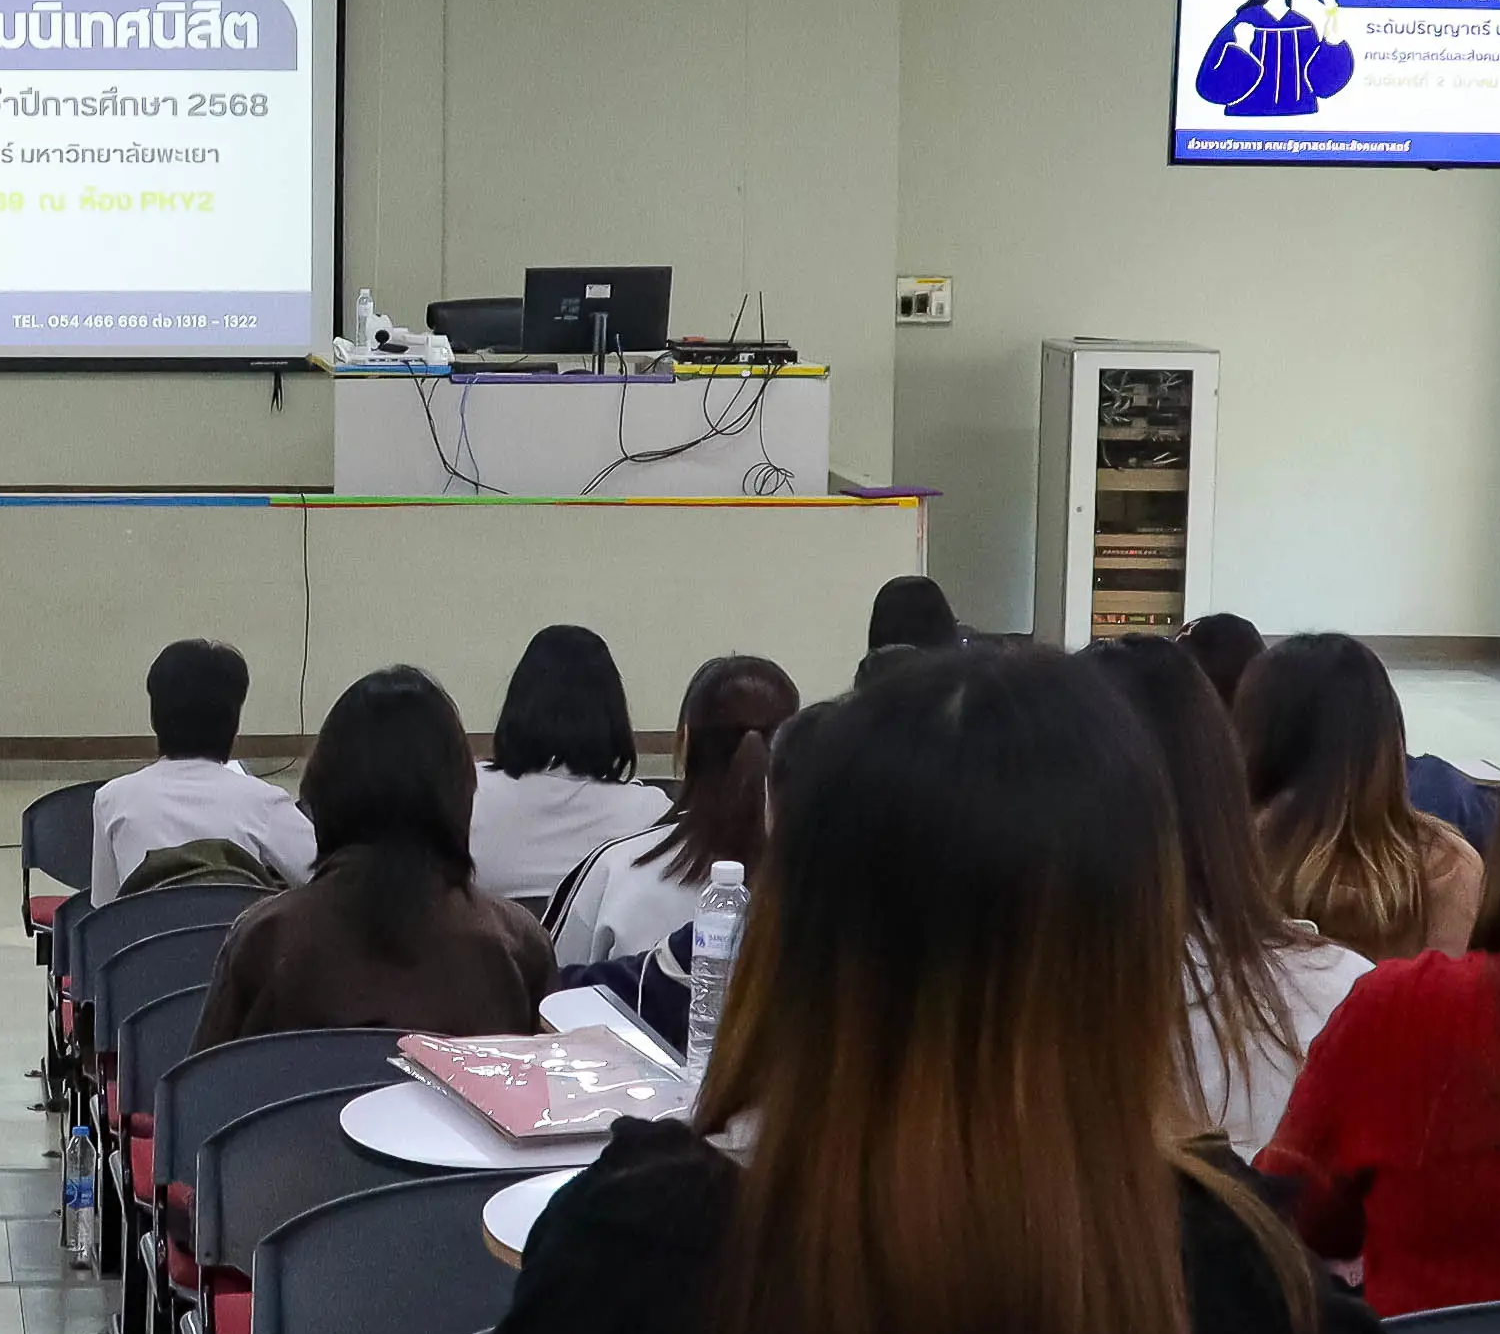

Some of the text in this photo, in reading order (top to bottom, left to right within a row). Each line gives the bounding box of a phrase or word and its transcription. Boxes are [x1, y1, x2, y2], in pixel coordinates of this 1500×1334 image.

[1366, 19, 1491, 38] ระดับปริญญาตรี
[188, 93, 269, 117] 2568
[21, 144, 220, 165] มหาวิทยาลัยพะเยา
[39, 193, 66, 213] ณ
[80, 184, 132, 213] ห้อง
[13, 315, 44, 328] TEL.
[48, 315, 79, 328] 054
[83, 315, 113, 328] 466
[118, 315, 148, 328] 666
[152, 313, 172, 328] ต่อ
[177, 315, 207, 328] 1318
[223, 315, 258, 328] 1322
